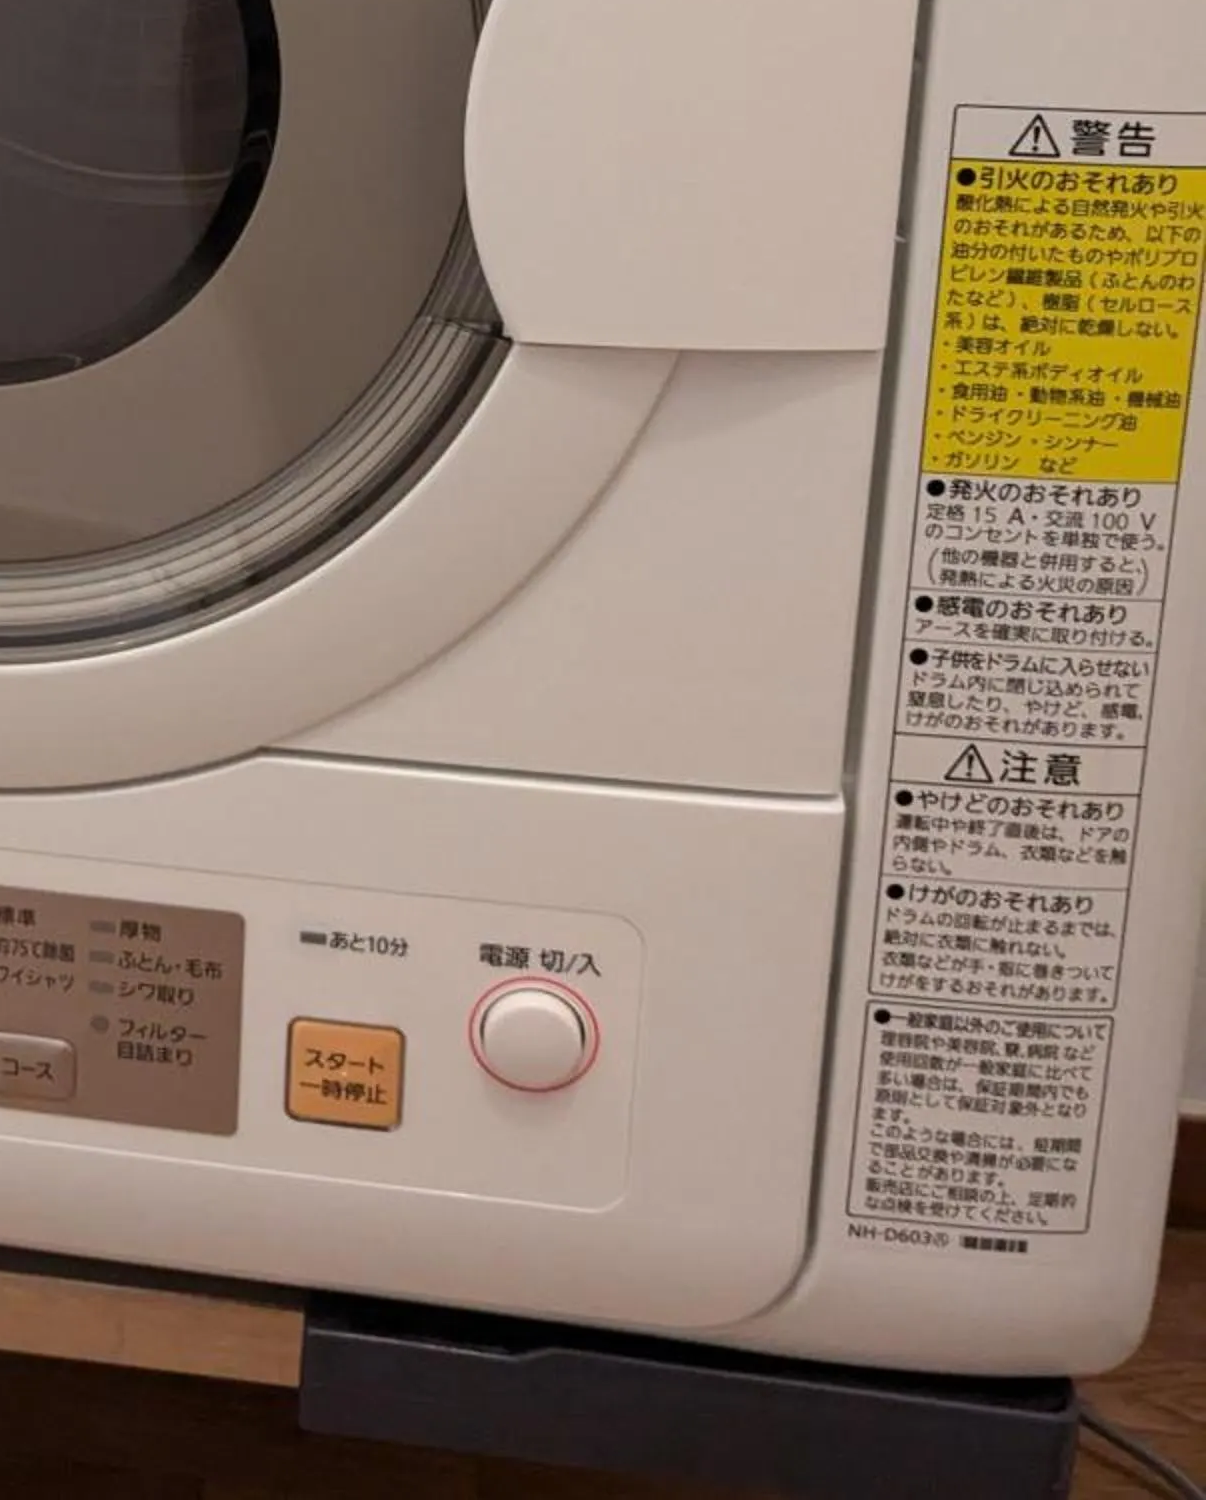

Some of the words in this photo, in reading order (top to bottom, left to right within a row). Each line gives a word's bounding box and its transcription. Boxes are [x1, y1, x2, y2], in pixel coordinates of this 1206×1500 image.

[1070, 119, 1156, 158] 警告
[979, 166, 1178, 196] 引火のおそれあり
[949, 479, 1142, 508] 発火のおそれあり
[925, 503, 965, 521] 定格
[1092, 512, 1130, 531] 100
[1140, 513, 1157, 531] V
[936, 596, 1127, 625] 感電のおそれあり
[931, 649, 1150, 677] 子供をドラムに入らせない
[1000, 749, 1083, 787] 注意
[918, 790, 1124, 821] やけどのおそれあり
[908, 883, 1094, 916] けがのおそれあり
[119, 920, 162, 942] 厚物
[329, 931, 409, 958] あと10分
[478, 943, 530, 970] 電源
[539, 949, 602, 978] 切/入
[118, 980, 196, 1007] シワ取り
[118, 1017, 209, 1043] フィルター
[117, 1042, 194, 1068] 目詰まり
[305, 1047, 386, 1074] スタート
[1, 1056, 54, 1083] コース
[299, 1079, 388, 1106] 一時停止
